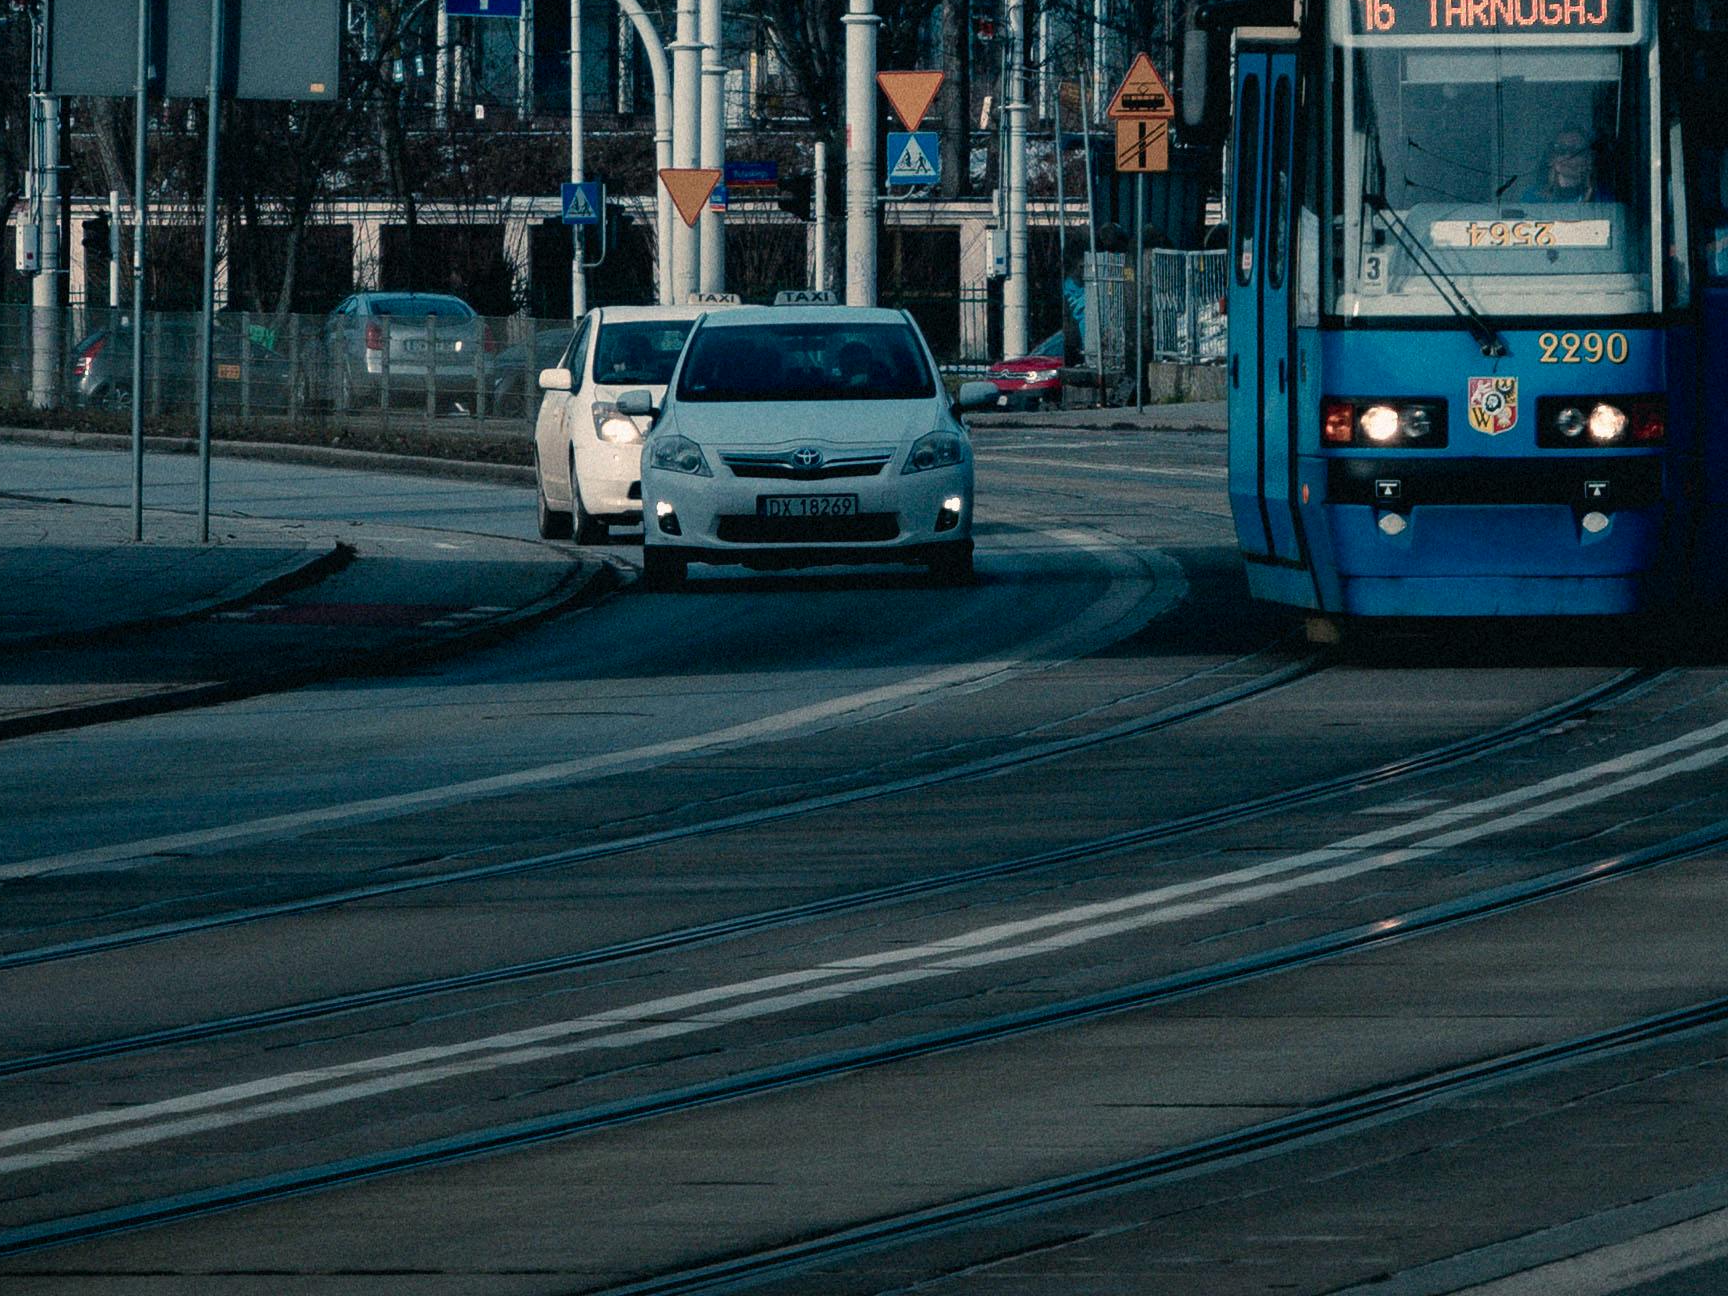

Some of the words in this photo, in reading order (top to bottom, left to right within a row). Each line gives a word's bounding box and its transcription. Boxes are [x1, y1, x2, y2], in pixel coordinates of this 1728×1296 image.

[1365, 255, 1381, 281] 3
[697, 293, 735, 304] TAXI
[783, 291, 830, 303] TAXI
[1537, 331, 1630, 365] 2290
[769, 499, 792, 517] DX
[799, 497, 853, 516] 18269
